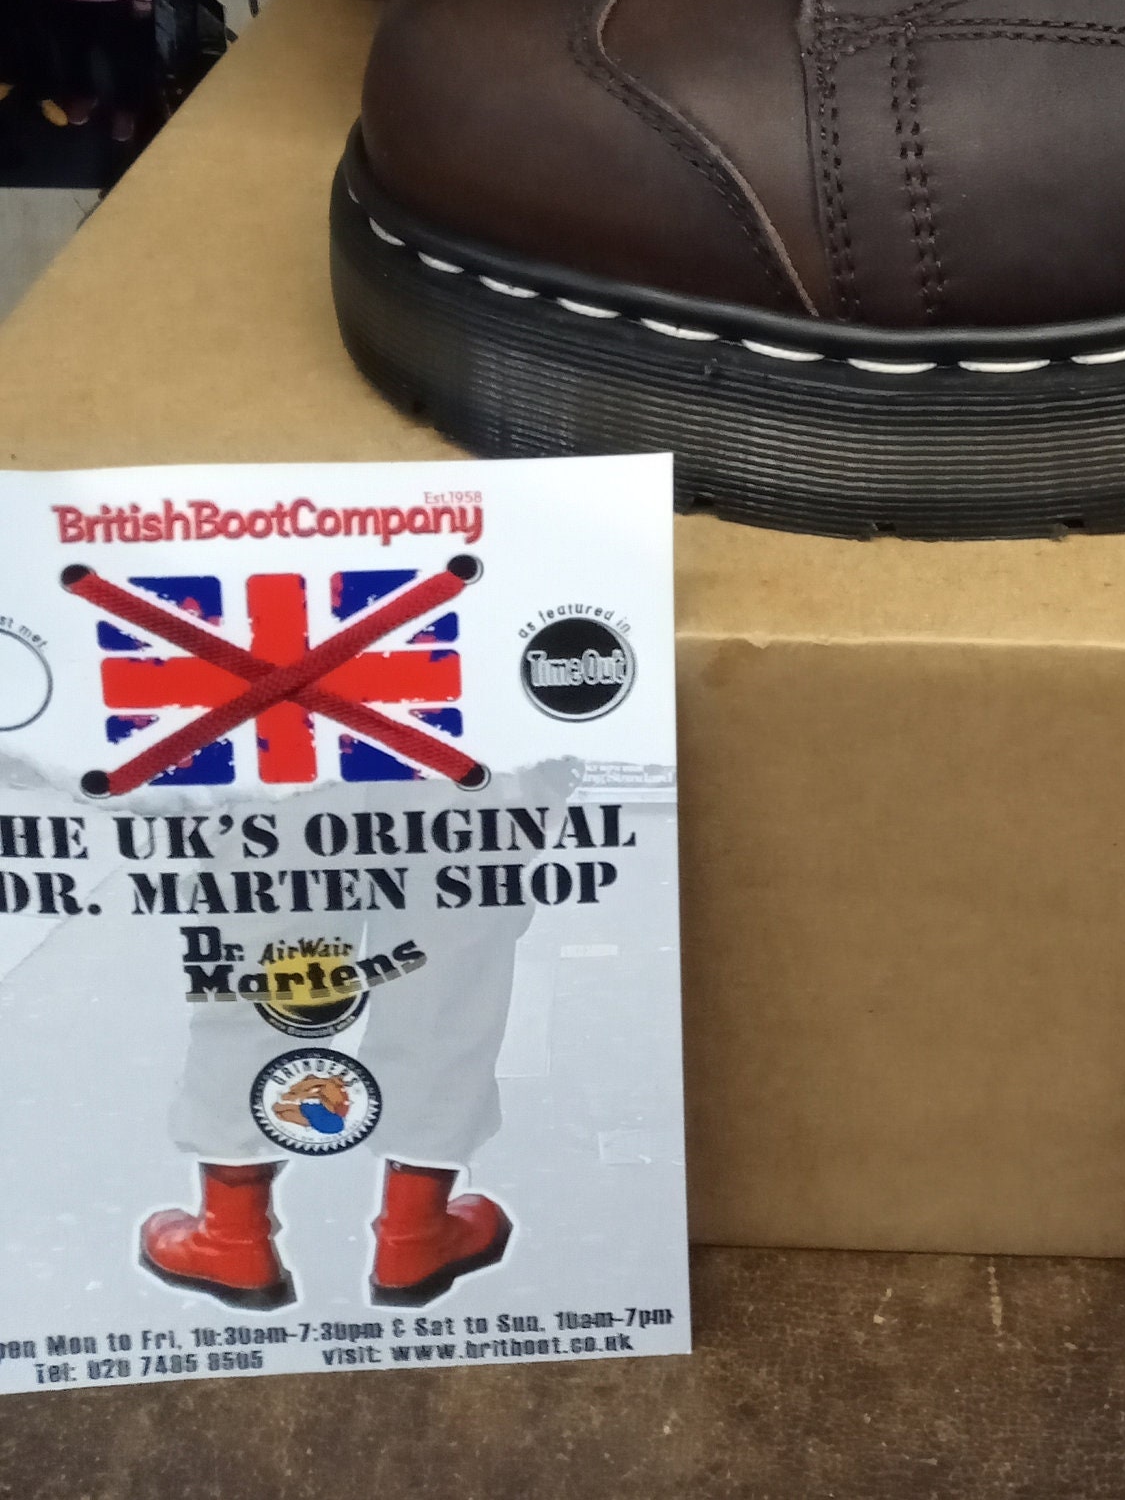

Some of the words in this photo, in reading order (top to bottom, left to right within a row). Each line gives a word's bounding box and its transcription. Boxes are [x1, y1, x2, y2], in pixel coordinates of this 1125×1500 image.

[52, 498, 484, 547] BritishBootCompany
[304, 804, 637, 857] ORIGINAL
[128, 867, 409, 915] MARTEN
[434, 861, 619, 909] SHOP
[183, 939, 428, 1002] Martens
[258, 936, 353, 965] AirWair
[47, 1335, 98, 1357] Mon
[107, 1332, 132, 1352] to
[414, 1317, 456, 1337] Sat
[463, 1316, 488, 1335] to
